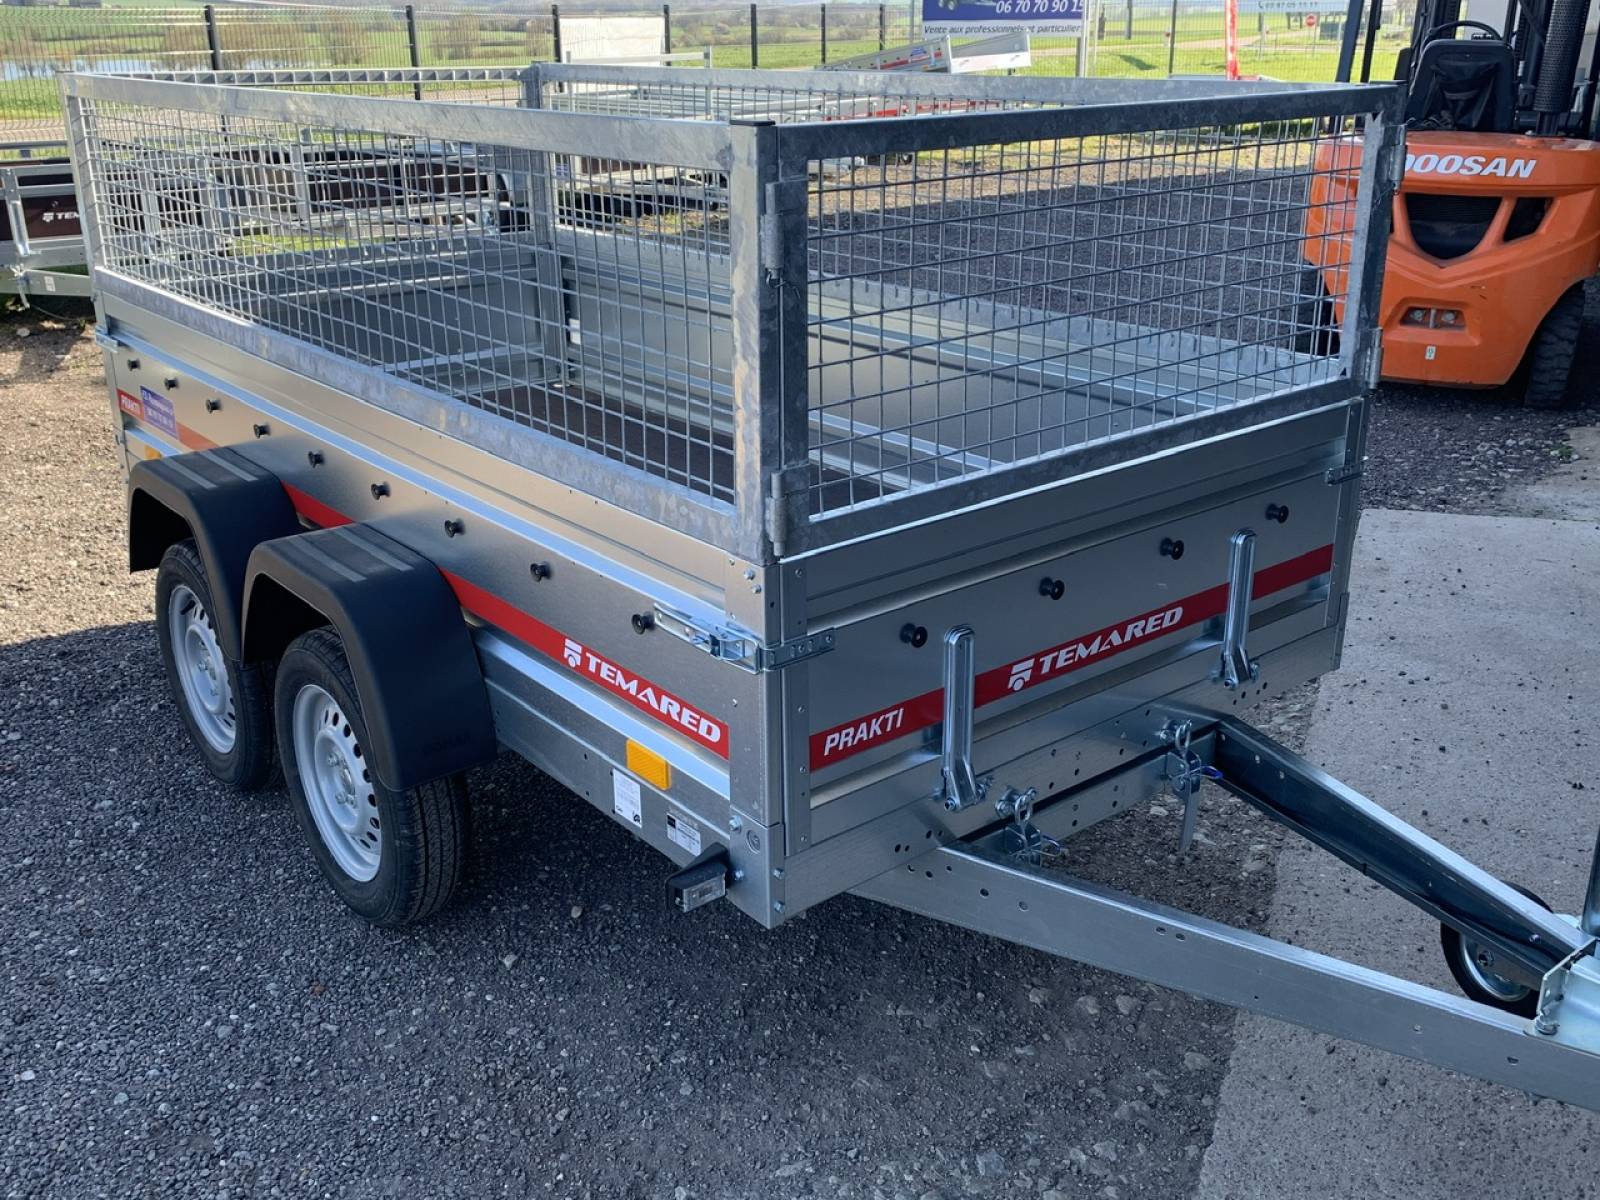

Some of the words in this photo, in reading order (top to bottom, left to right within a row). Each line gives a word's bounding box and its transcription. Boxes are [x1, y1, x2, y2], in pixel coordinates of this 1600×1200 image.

[924, 25, 948, 34] Vente
[949, 26, 963, 34] aux
[964, 24, 1025, 35] professionnels
[996, 0, 1012, 13] 06
[1015, 0, 1030, 13] 70
[1033, 0, 1049, 13] 70
[1051, 0, 1068, 12] 90
[1038, 606, 1183, 675] TEMARED
[586, 651, 721, 743] TEMARED
[823, 708, 904, 756] PRAKTI
